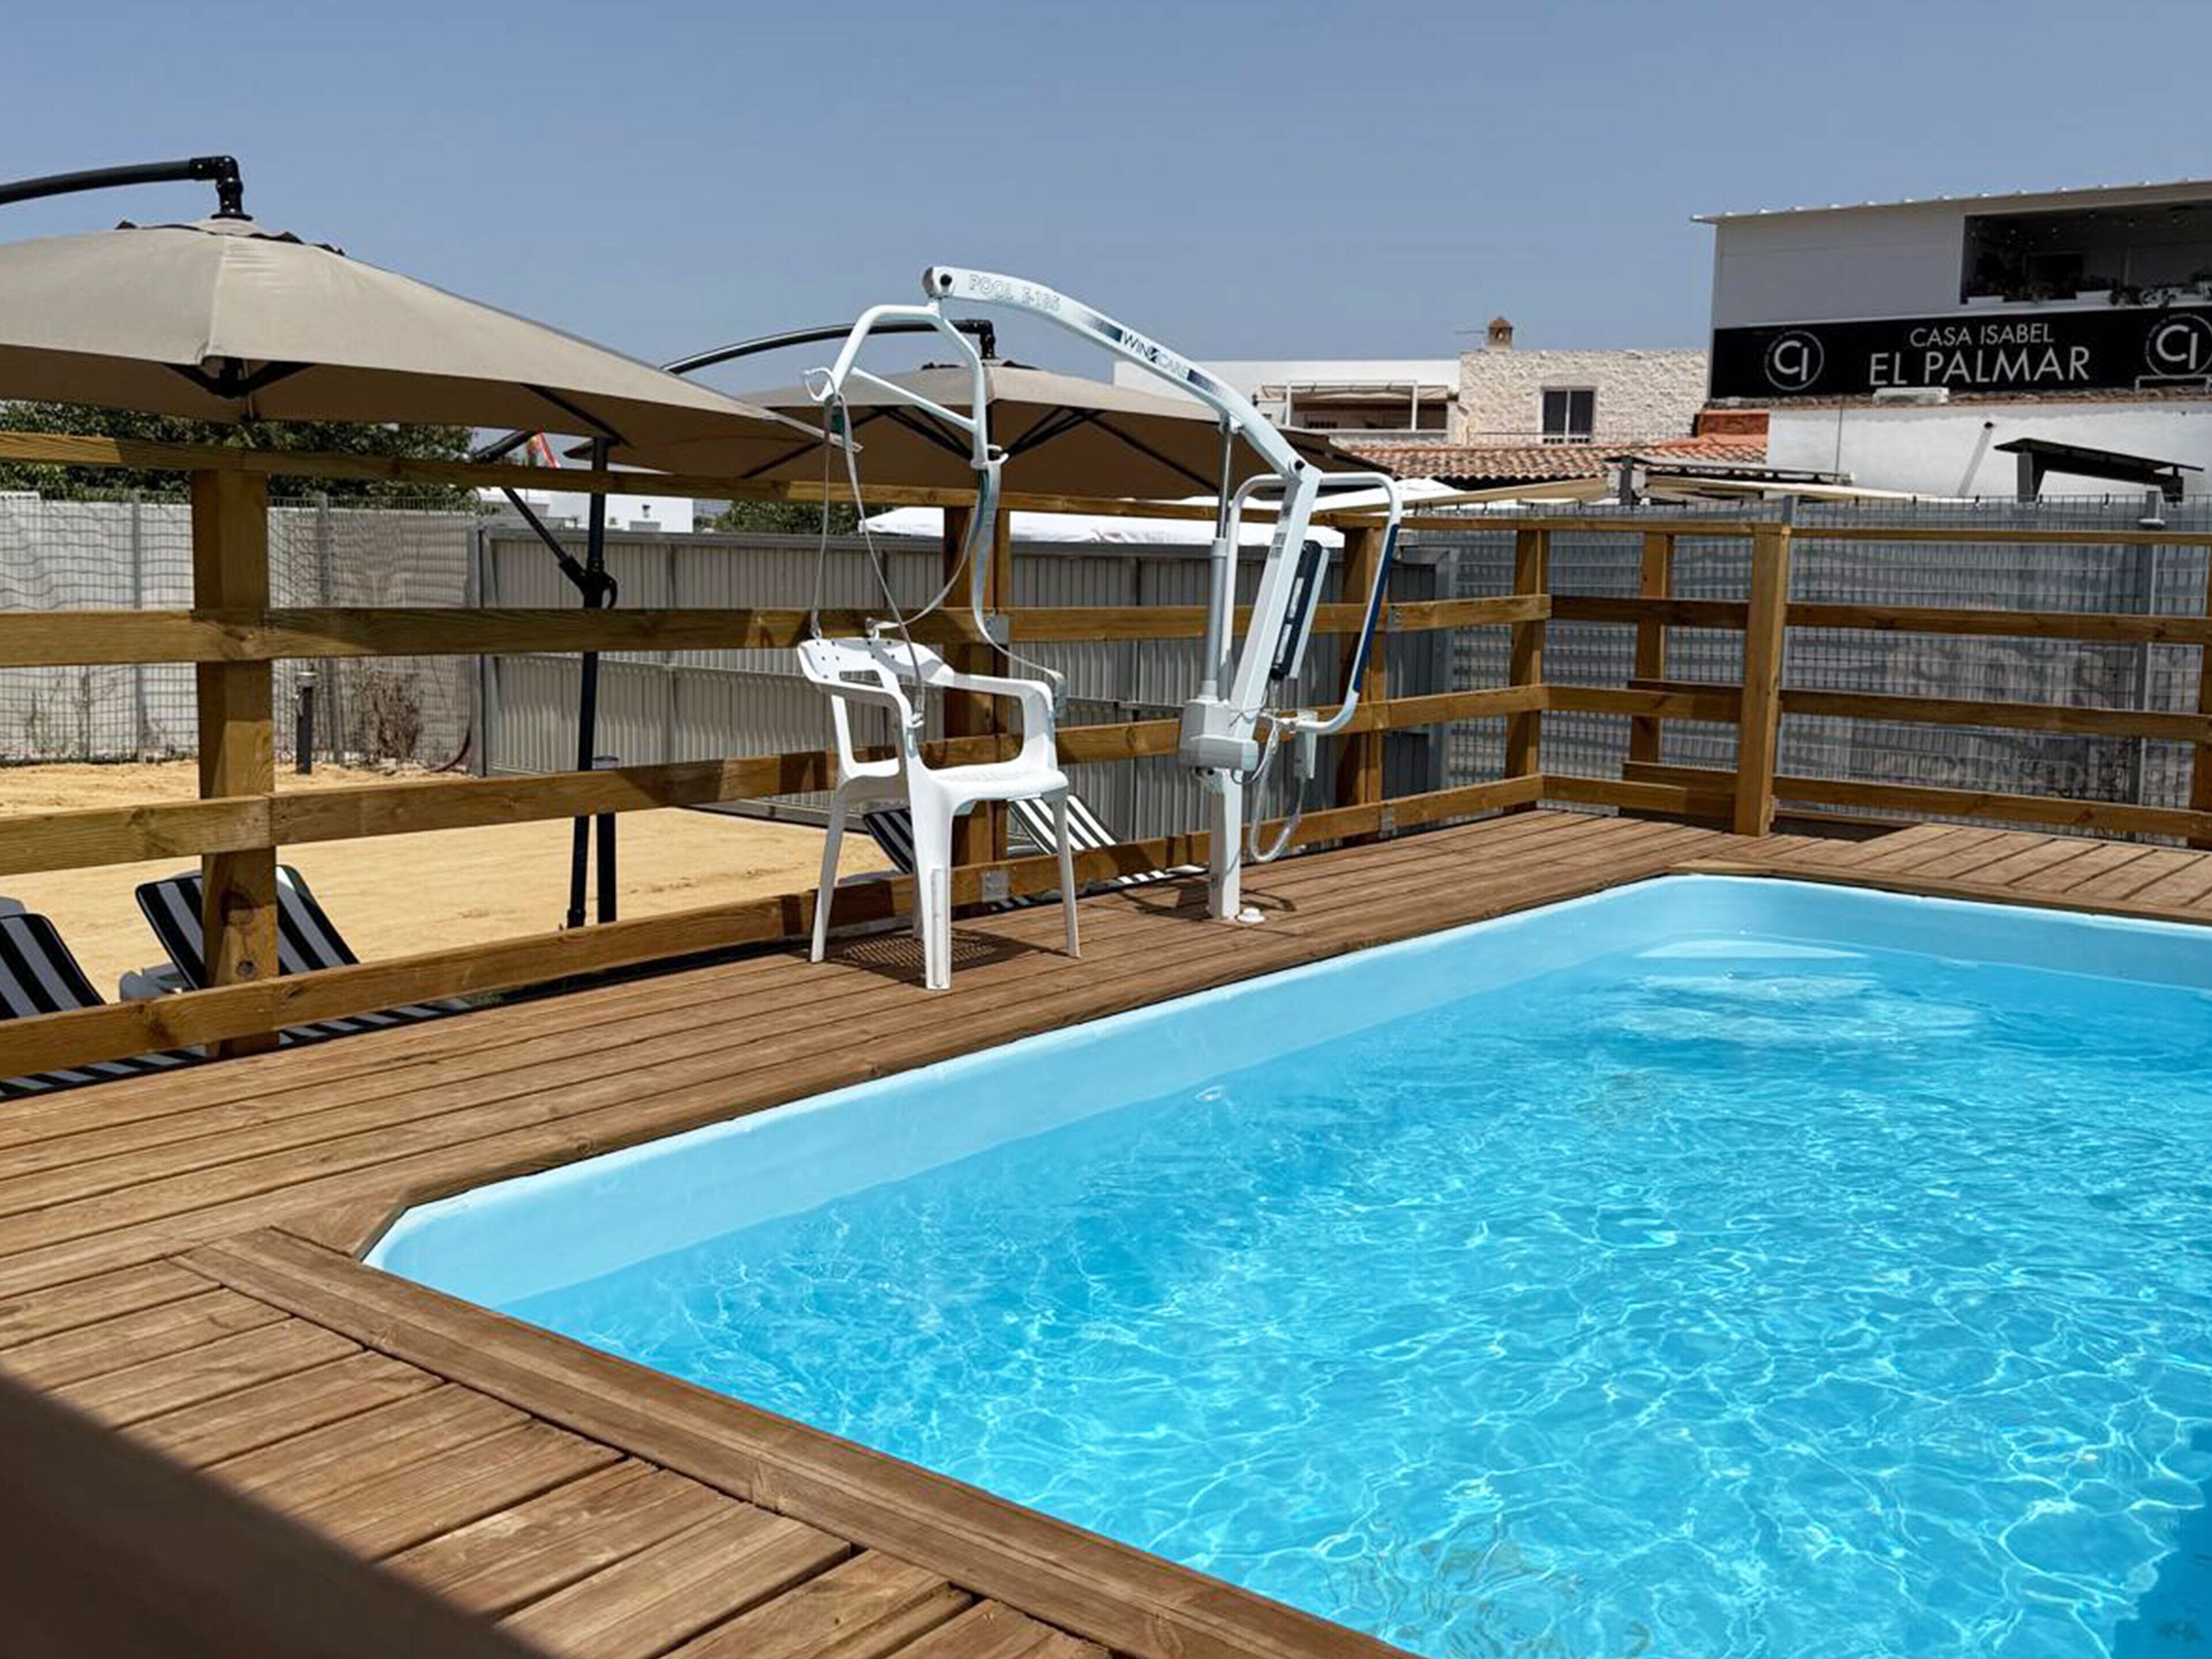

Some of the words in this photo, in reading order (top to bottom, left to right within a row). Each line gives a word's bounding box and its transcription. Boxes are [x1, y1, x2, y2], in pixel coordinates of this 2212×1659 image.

[1910, 327, 1972, 347] CASA
[1980, 323, 2054, 344] ISABEL
[1869, 351, 1908, 385] EL
[1923, 346, 2090, 384] PALMAR
